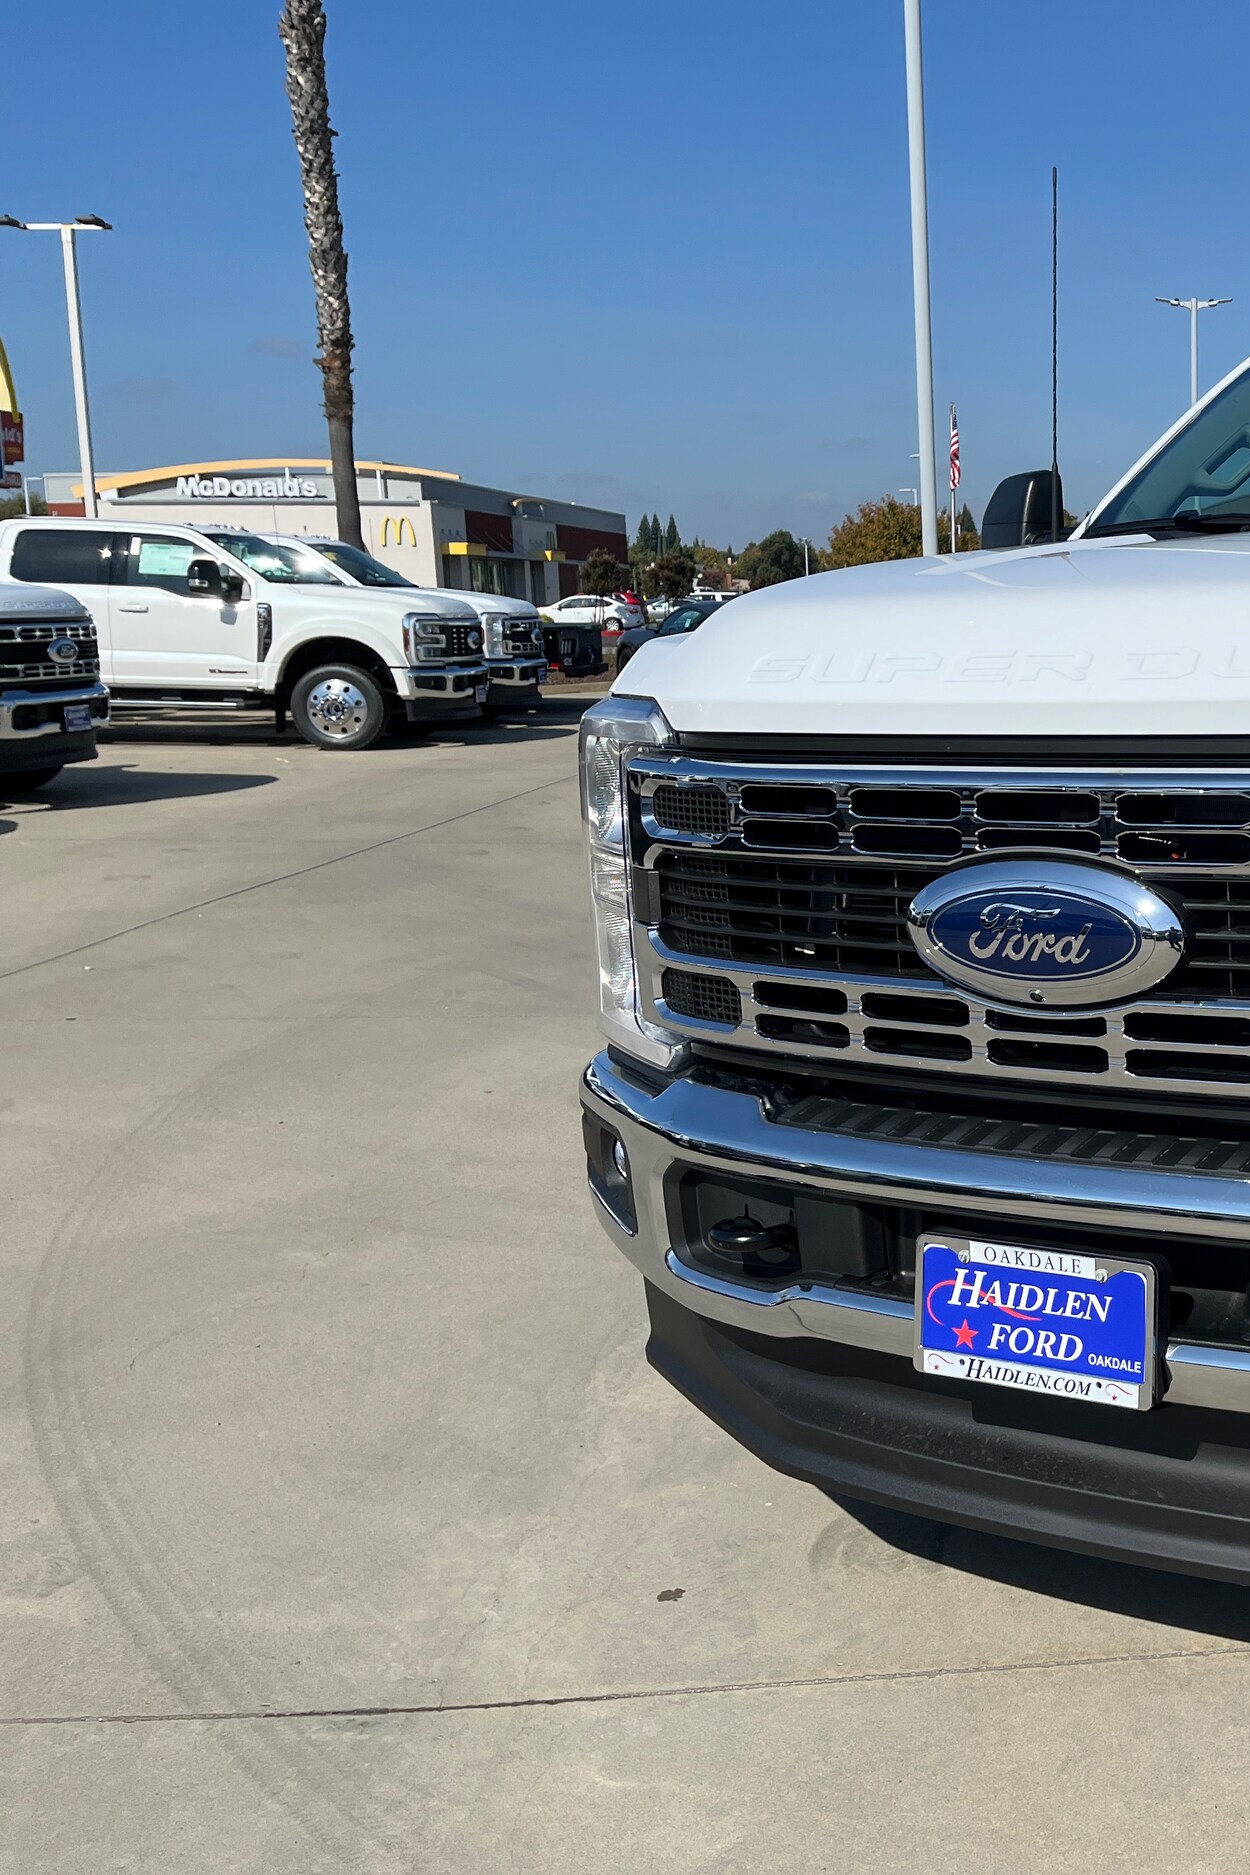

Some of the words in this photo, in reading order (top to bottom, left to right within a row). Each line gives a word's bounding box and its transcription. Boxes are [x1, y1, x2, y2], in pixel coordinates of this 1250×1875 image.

[175, 474, 318, 498] McDonald's
[744, 648, 1096, 685] SUPER
[968, 901, 1094, 965] Ford
[983, 1246, 1083, 1275] OAKDALE
[947, 1268, 1114, 1324] HAIDLEN
[986, 1322, 1084, 1362] FORD
[965, 1357, 1093, 1397] HAIDLEN.COM
[1087, 1352, 1142, 1374] OAKDALE
